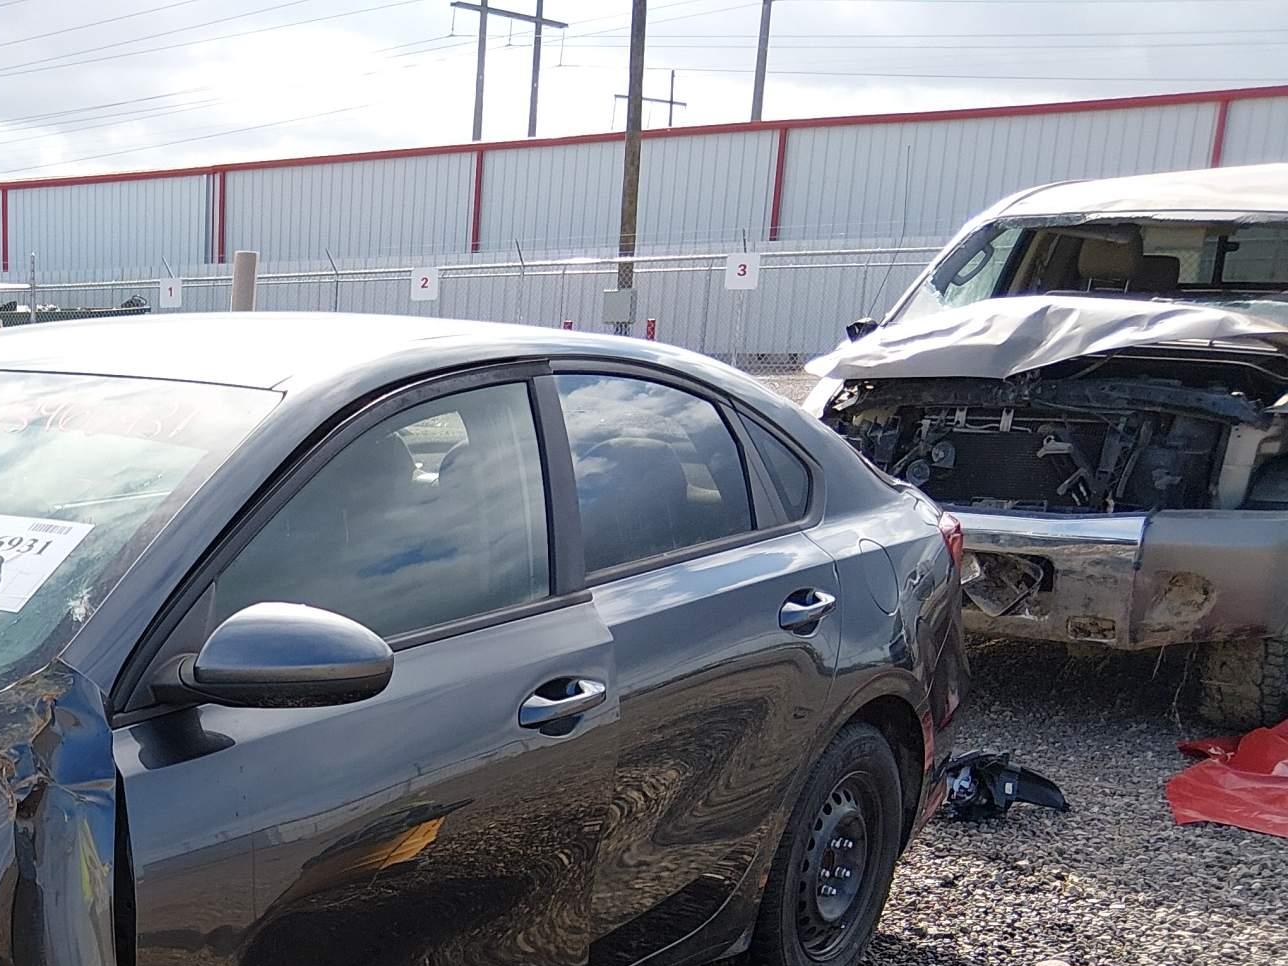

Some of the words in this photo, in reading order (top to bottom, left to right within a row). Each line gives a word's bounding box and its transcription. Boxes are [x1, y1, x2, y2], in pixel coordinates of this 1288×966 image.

[737, 264, 747, 276] 3
[421, 277, 429, 288] 2
[168, 287, 173, 296] 1
